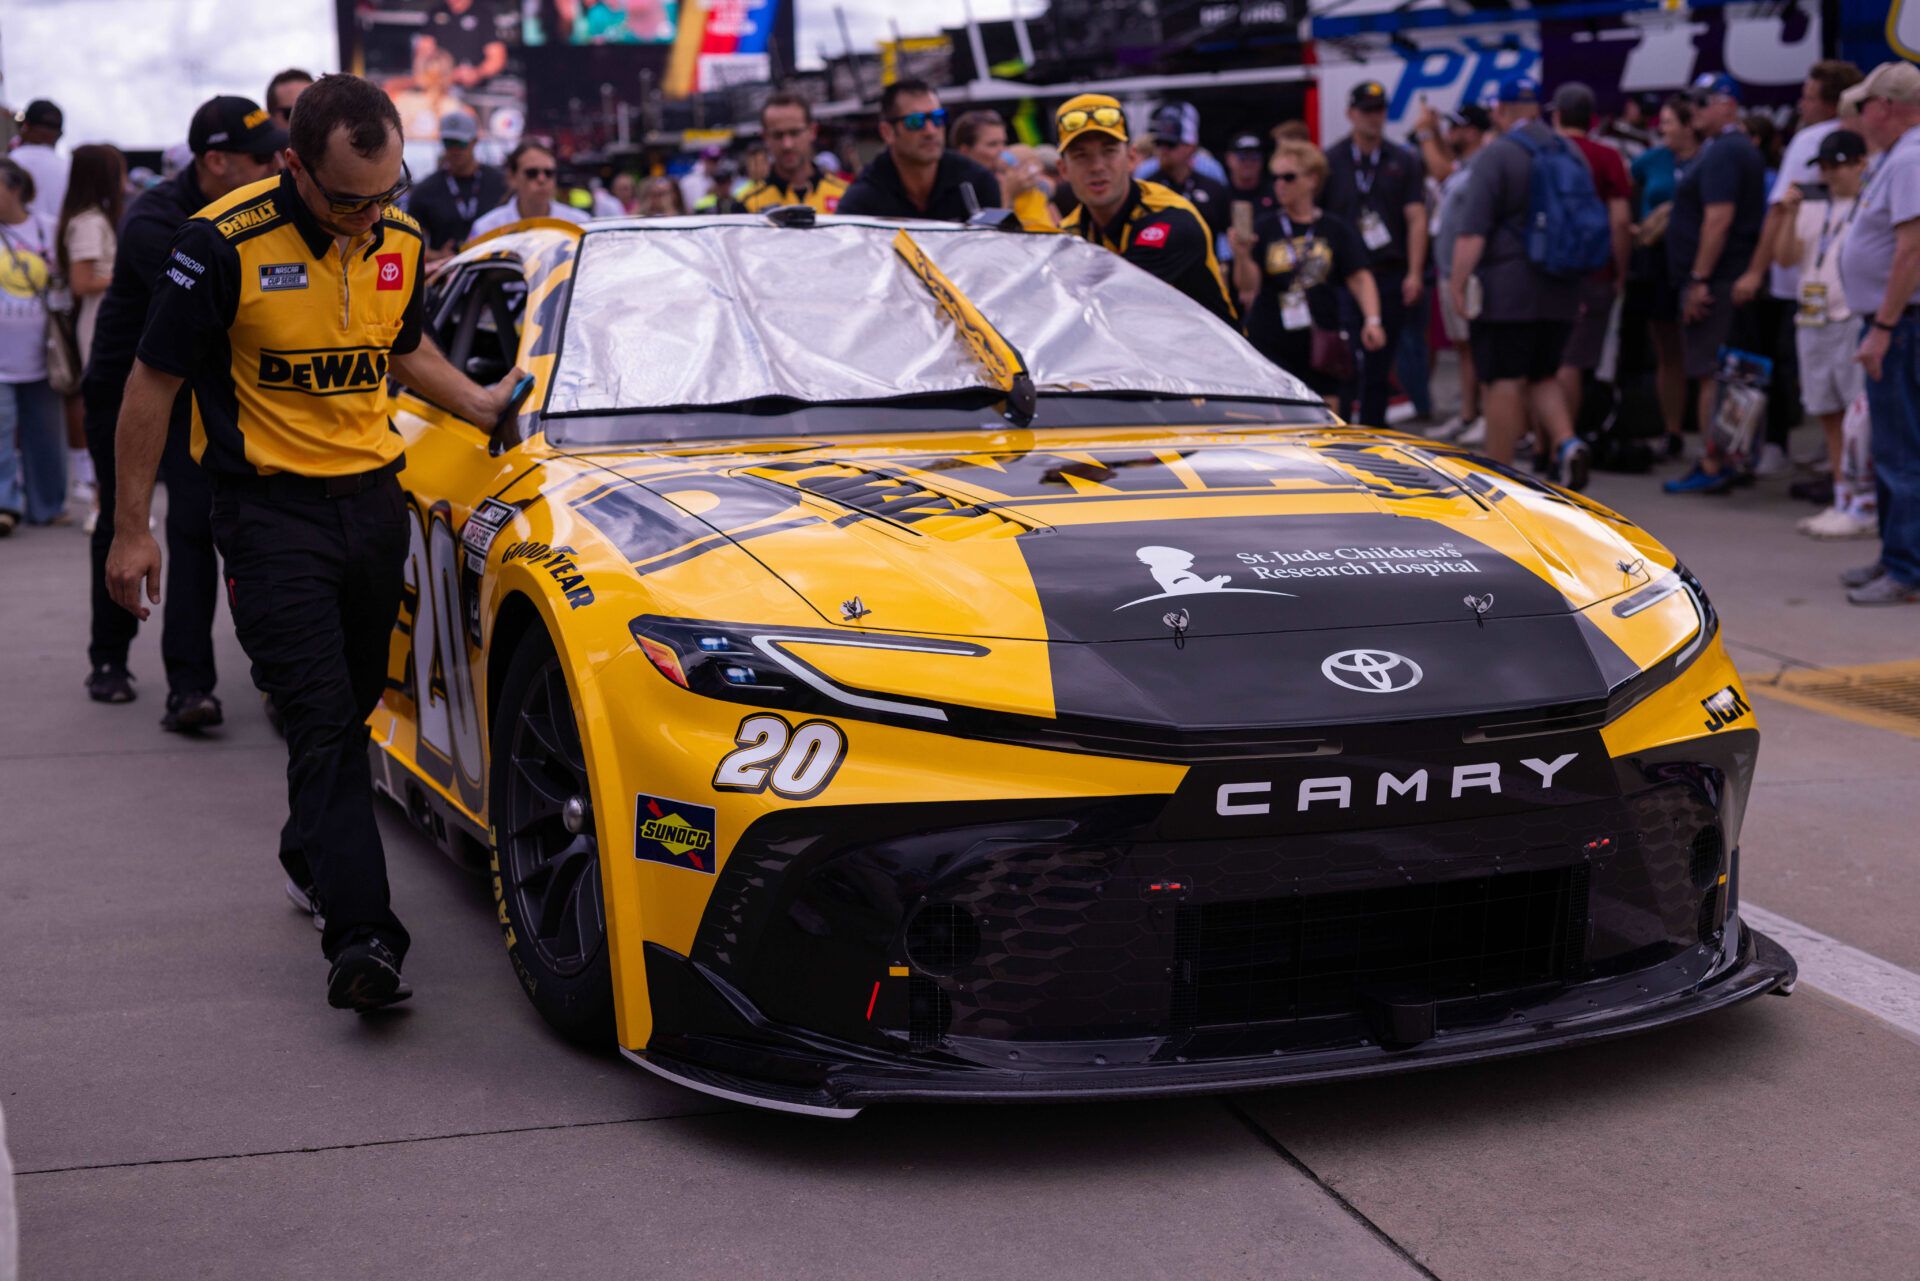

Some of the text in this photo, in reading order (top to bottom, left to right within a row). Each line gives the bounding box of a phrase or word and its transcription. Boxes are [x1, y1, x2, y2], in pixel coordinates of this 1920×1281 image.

[172, 249, 206, 275] NASCAR
[272, 265, 300, 276] NASCAR
[166, 267, 196, 291] JGR
[267, 274, 302, 286] CUP SERIES
[1236, 552, 1275, 565] St.
[1273, 550, 1335, 566] Jude
[1249, 559, 1482, 579] Research Hospital
[501, 541, 596, 610] GOODYEAR
[1700, 684, 1751, 733] JGR
[713, 713, 846, 798] 20
[1215, 752, 1580, 817] CAMRY
[643, 820, 712, 849] SUNOCO
